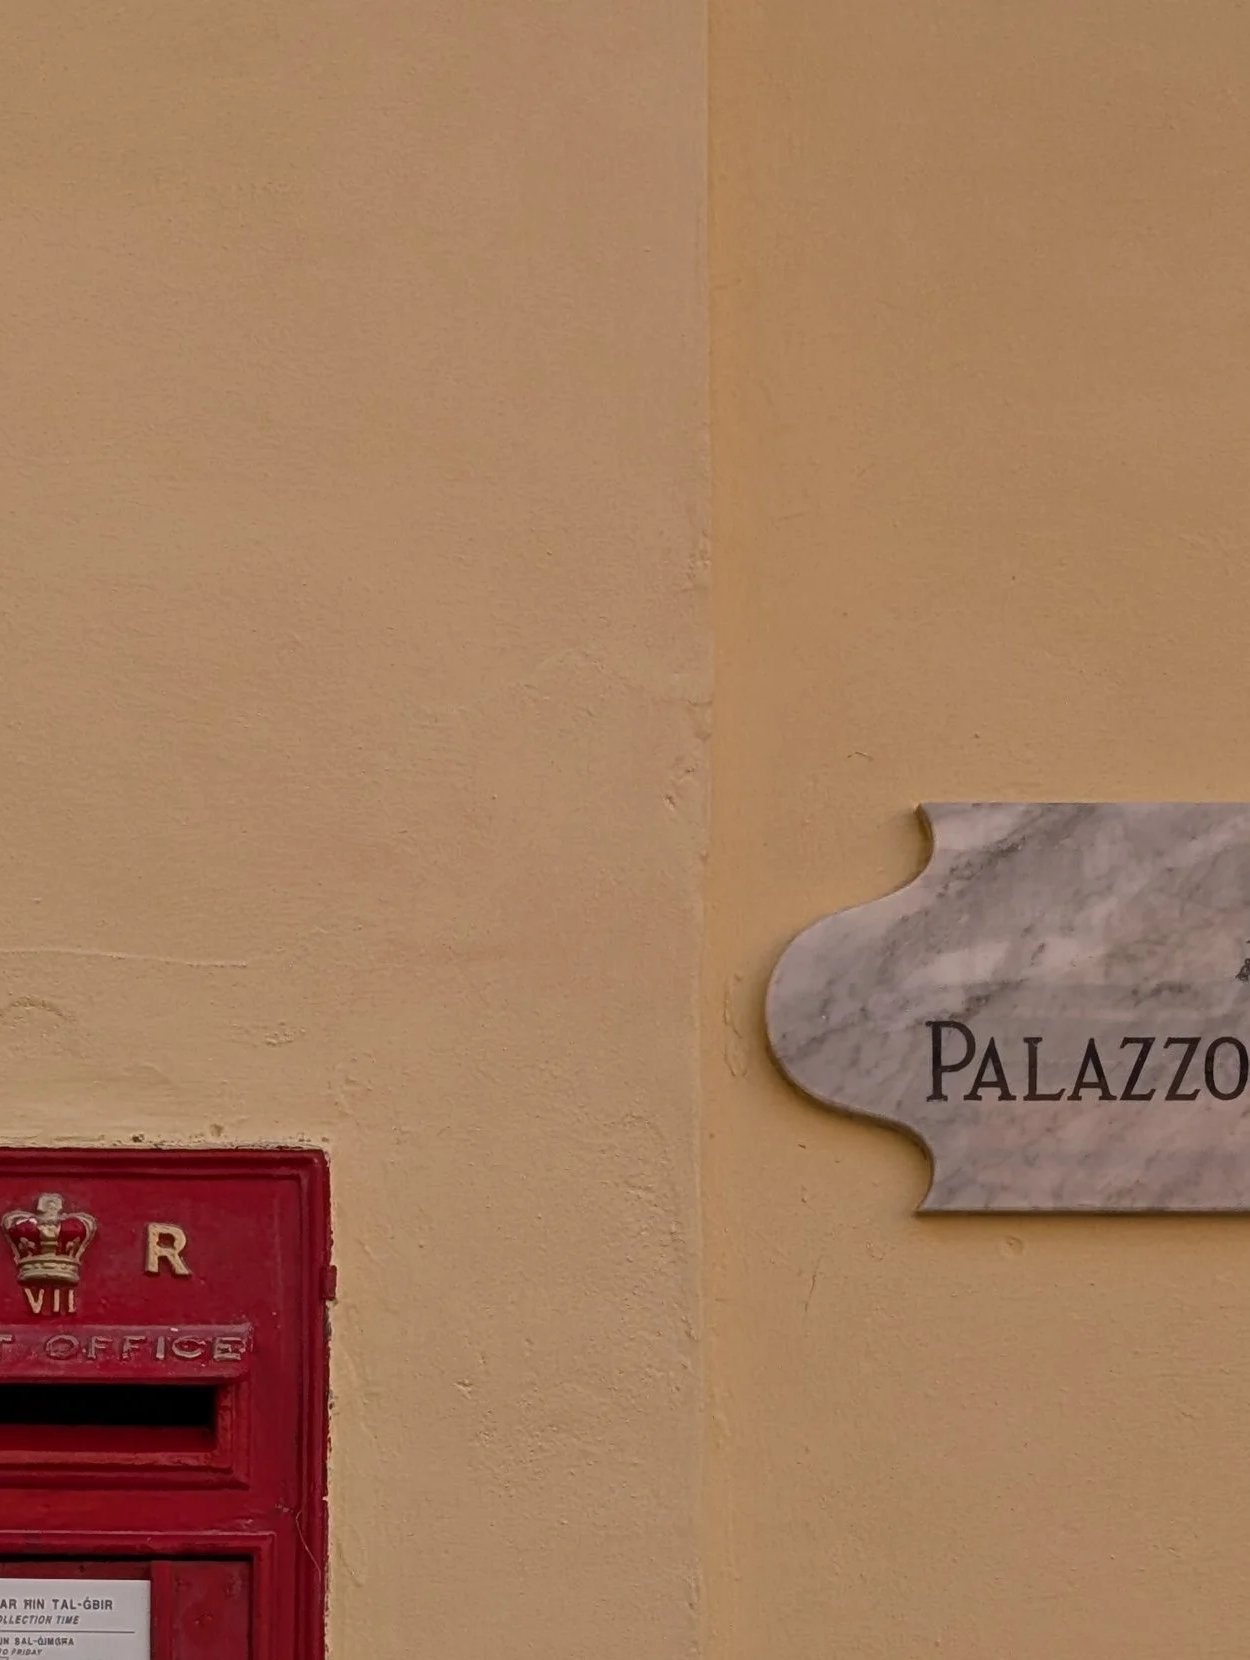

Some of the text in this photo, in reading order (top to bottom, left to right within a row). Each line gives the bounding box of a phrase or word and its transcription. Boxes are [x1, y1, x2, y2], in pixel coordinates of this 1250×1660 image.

[925, 1019, 1250, 1103] PALAZZO
[146, 1221, 193, 1278] R
[23, 1287, 77, 1315] VII
[45, 1332, 246, 1363] OFFICE
[55, 1615, 80, 1625] TIME
[10, 1648, 43, 1656] FRIDAY
